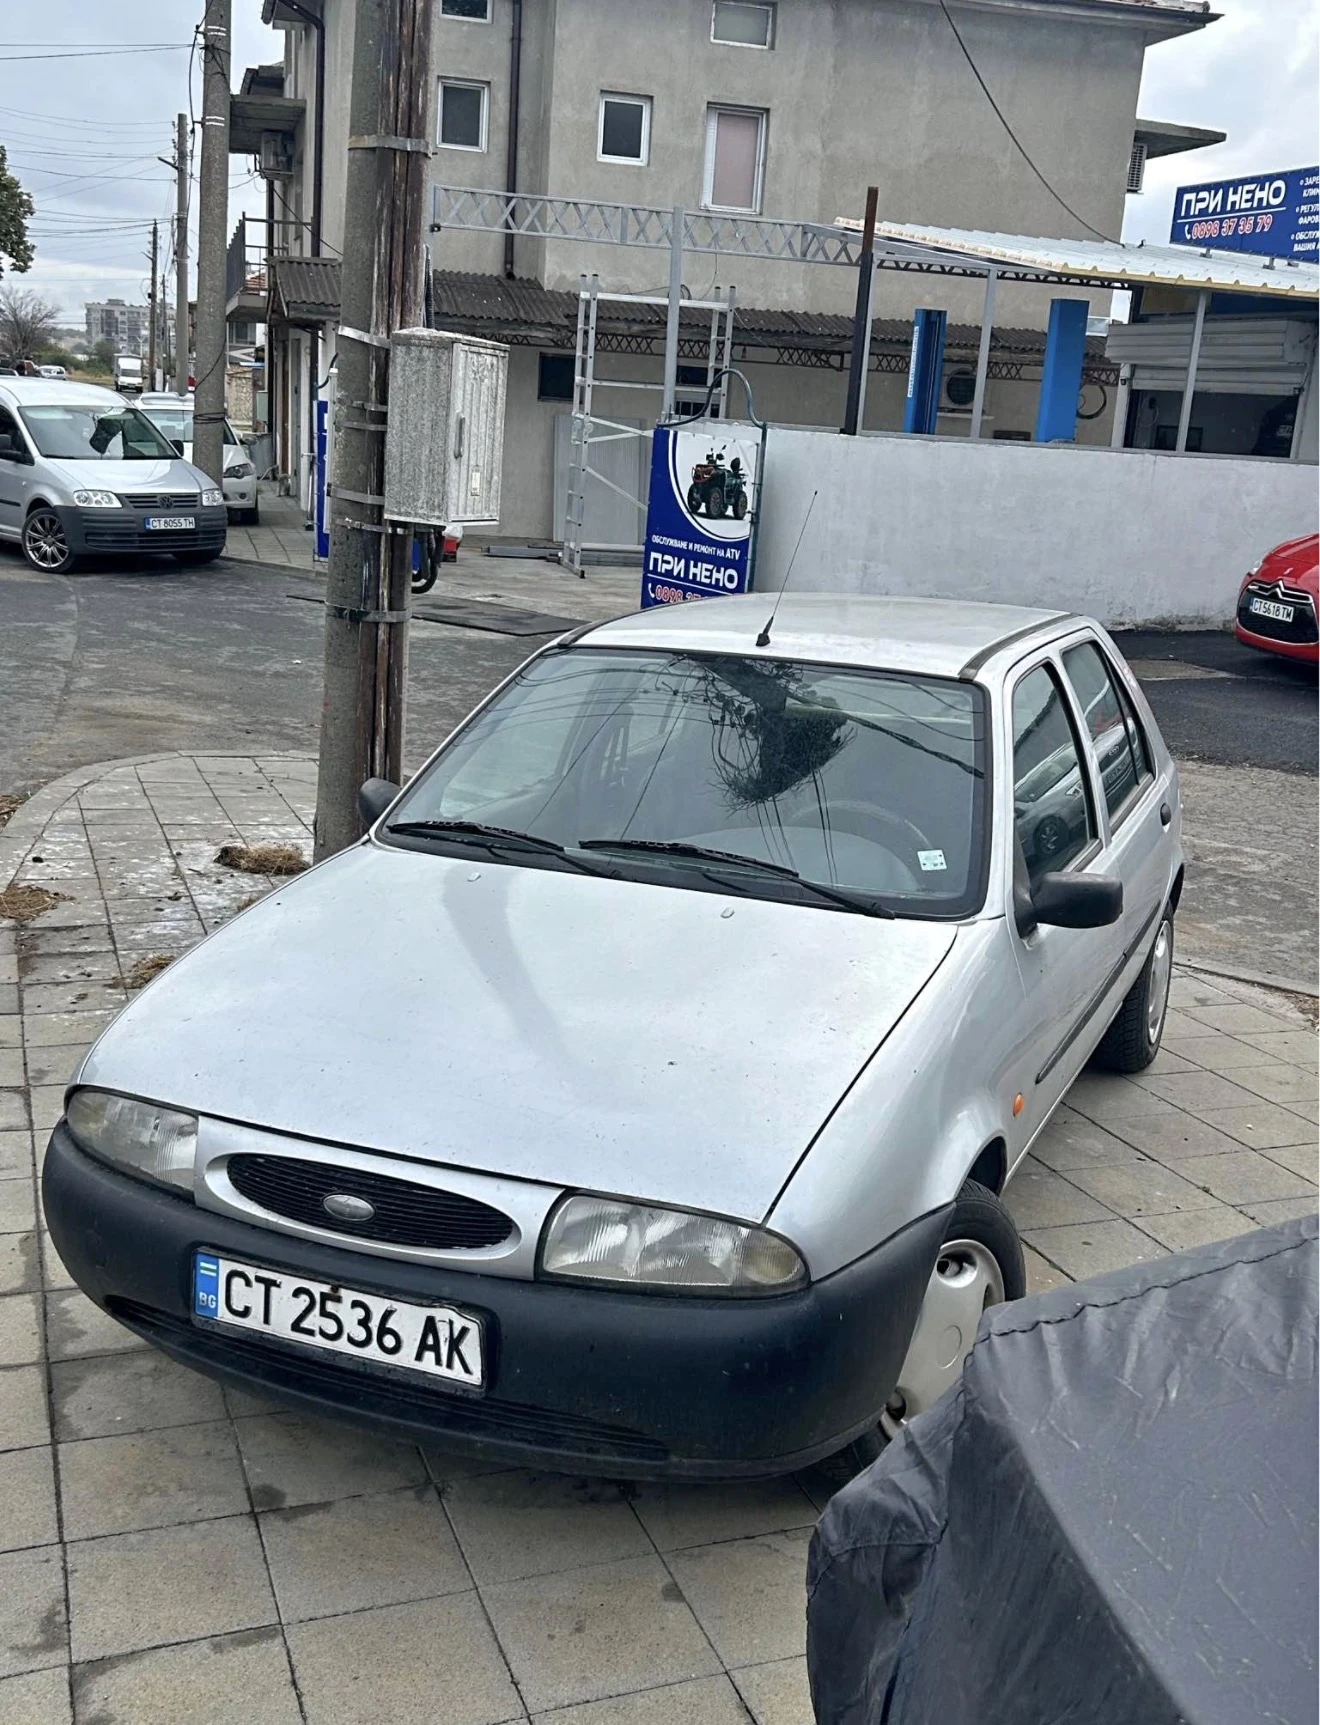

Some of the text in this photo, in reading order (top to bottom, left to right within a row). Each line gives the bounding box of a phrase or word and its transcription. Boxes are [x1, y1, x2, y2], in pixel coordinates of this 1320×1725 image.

[1181, 179, 1286, 217] ПРИ НЕНО
[1192, 214, 1273, 240] 0898 37 35 79
[152, 518, 194, 528] CT 8055 TH
[652, 534, 741, 560] ОБСЛУЖВАНЕ И РЕМОНТ НА ATV
[649, 551, 739, 589] ПРИ НЕНО
[656, 584, 683, 603] 0898
[1263, 602, 1280, 617] 5618
[1282, 607, 1292, 620] TM
[199, 1291, 217, 1309] BG
[225, 1269, 473, 1375] CT 2536 AK
